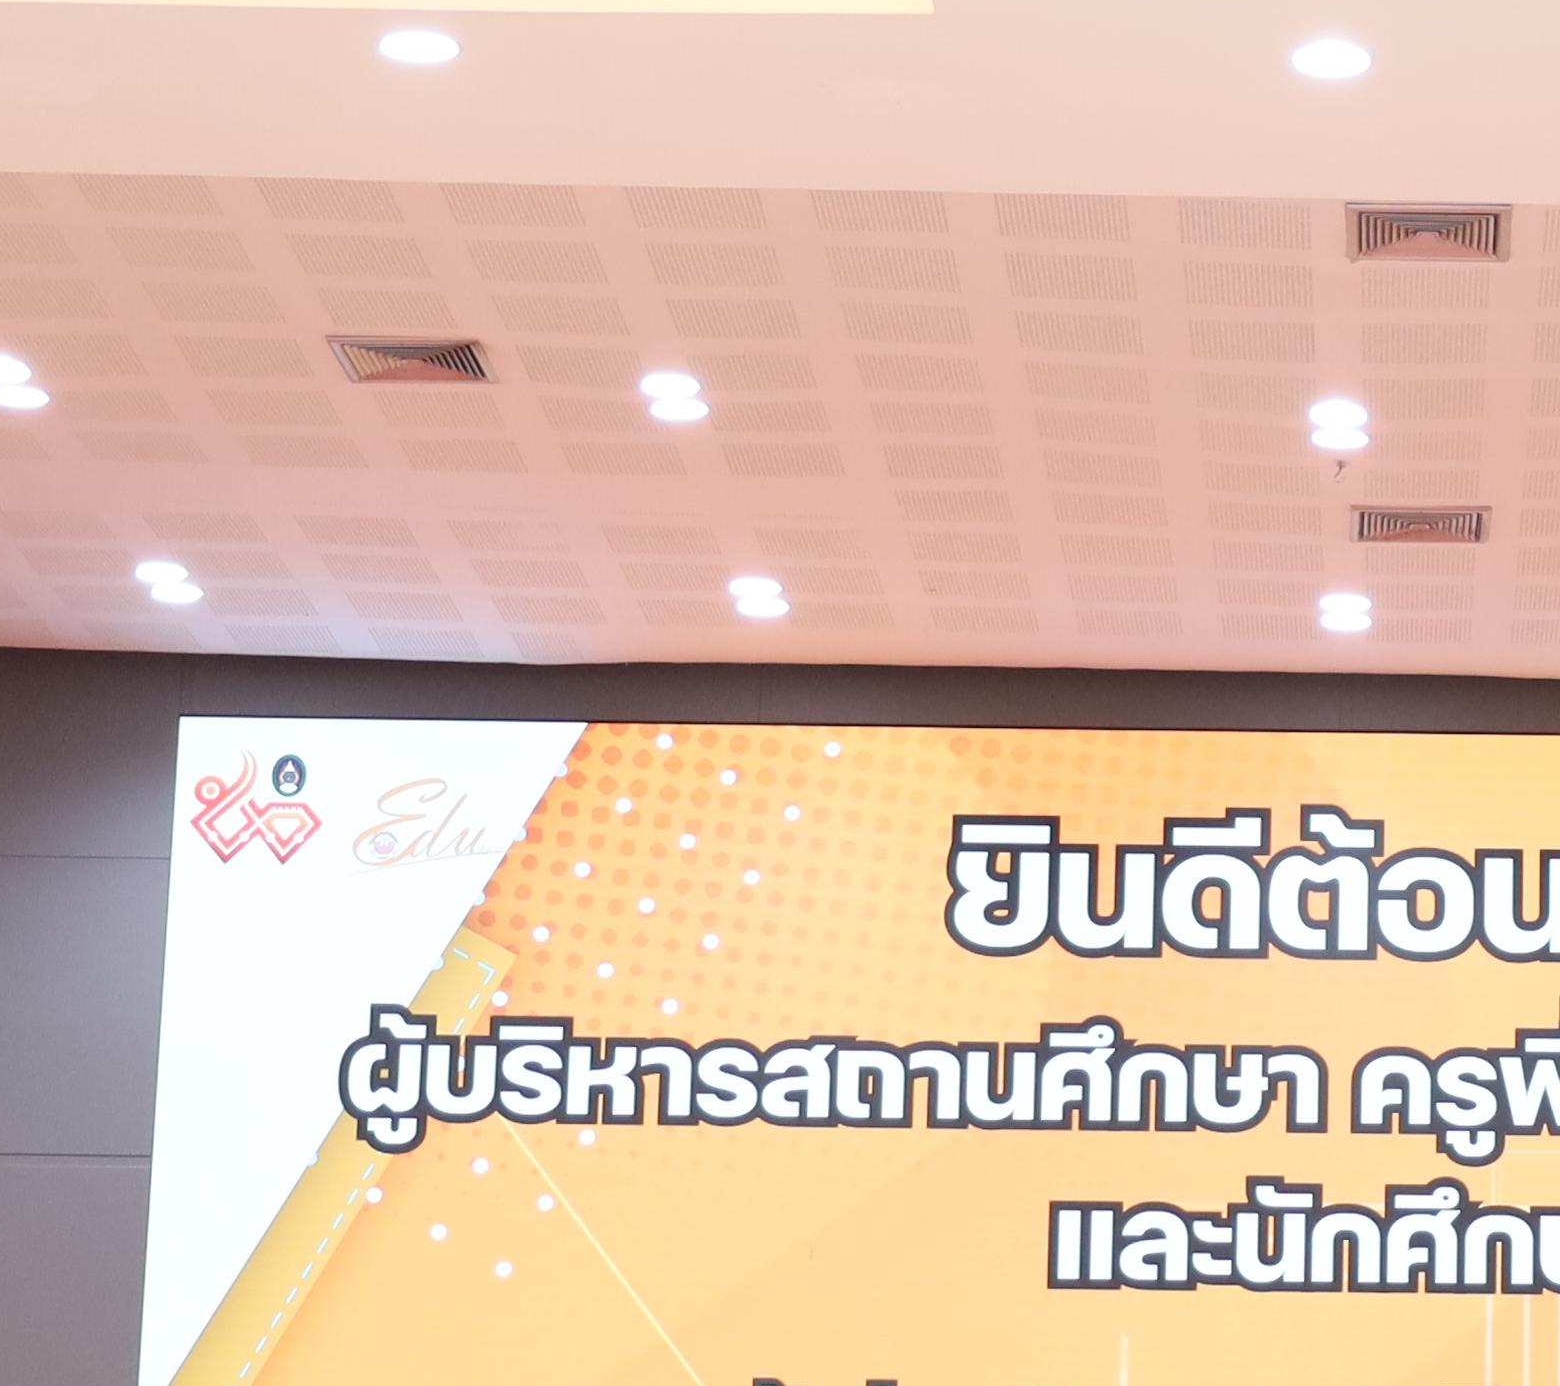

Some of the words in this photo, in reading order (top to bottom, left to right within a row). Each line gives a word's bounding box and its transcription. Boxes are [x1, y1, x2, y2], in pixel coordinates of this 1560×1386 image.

[351, 778, 487, 866] Edu
[340, 1004, 1327, 1152] ผู้บริหารสถานศึกษา
